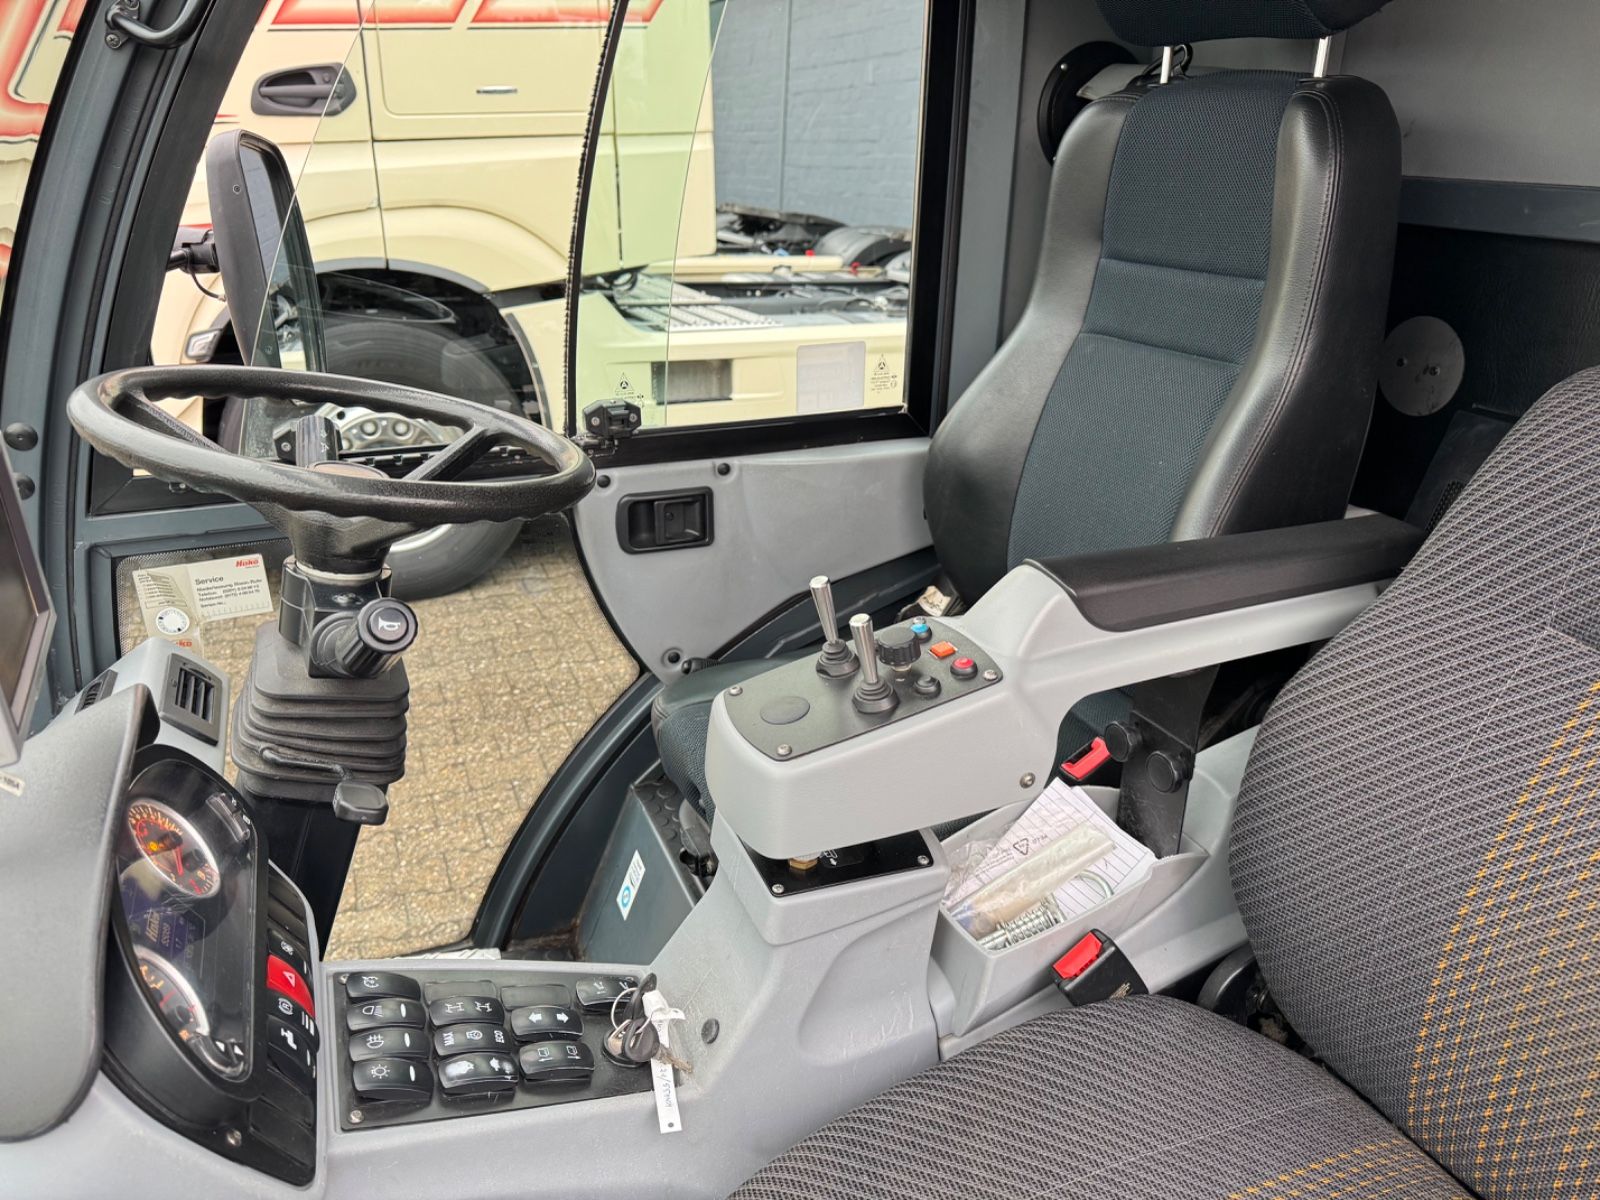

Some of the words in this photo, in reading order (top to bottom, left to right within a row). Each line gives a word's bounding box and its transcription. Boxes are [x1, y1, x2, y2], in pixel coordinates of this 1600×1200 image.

[235, 559, 259, 568] Hako
[195, 575, 224, 586] Service
[443, 1031, 455, 1046] MAX
